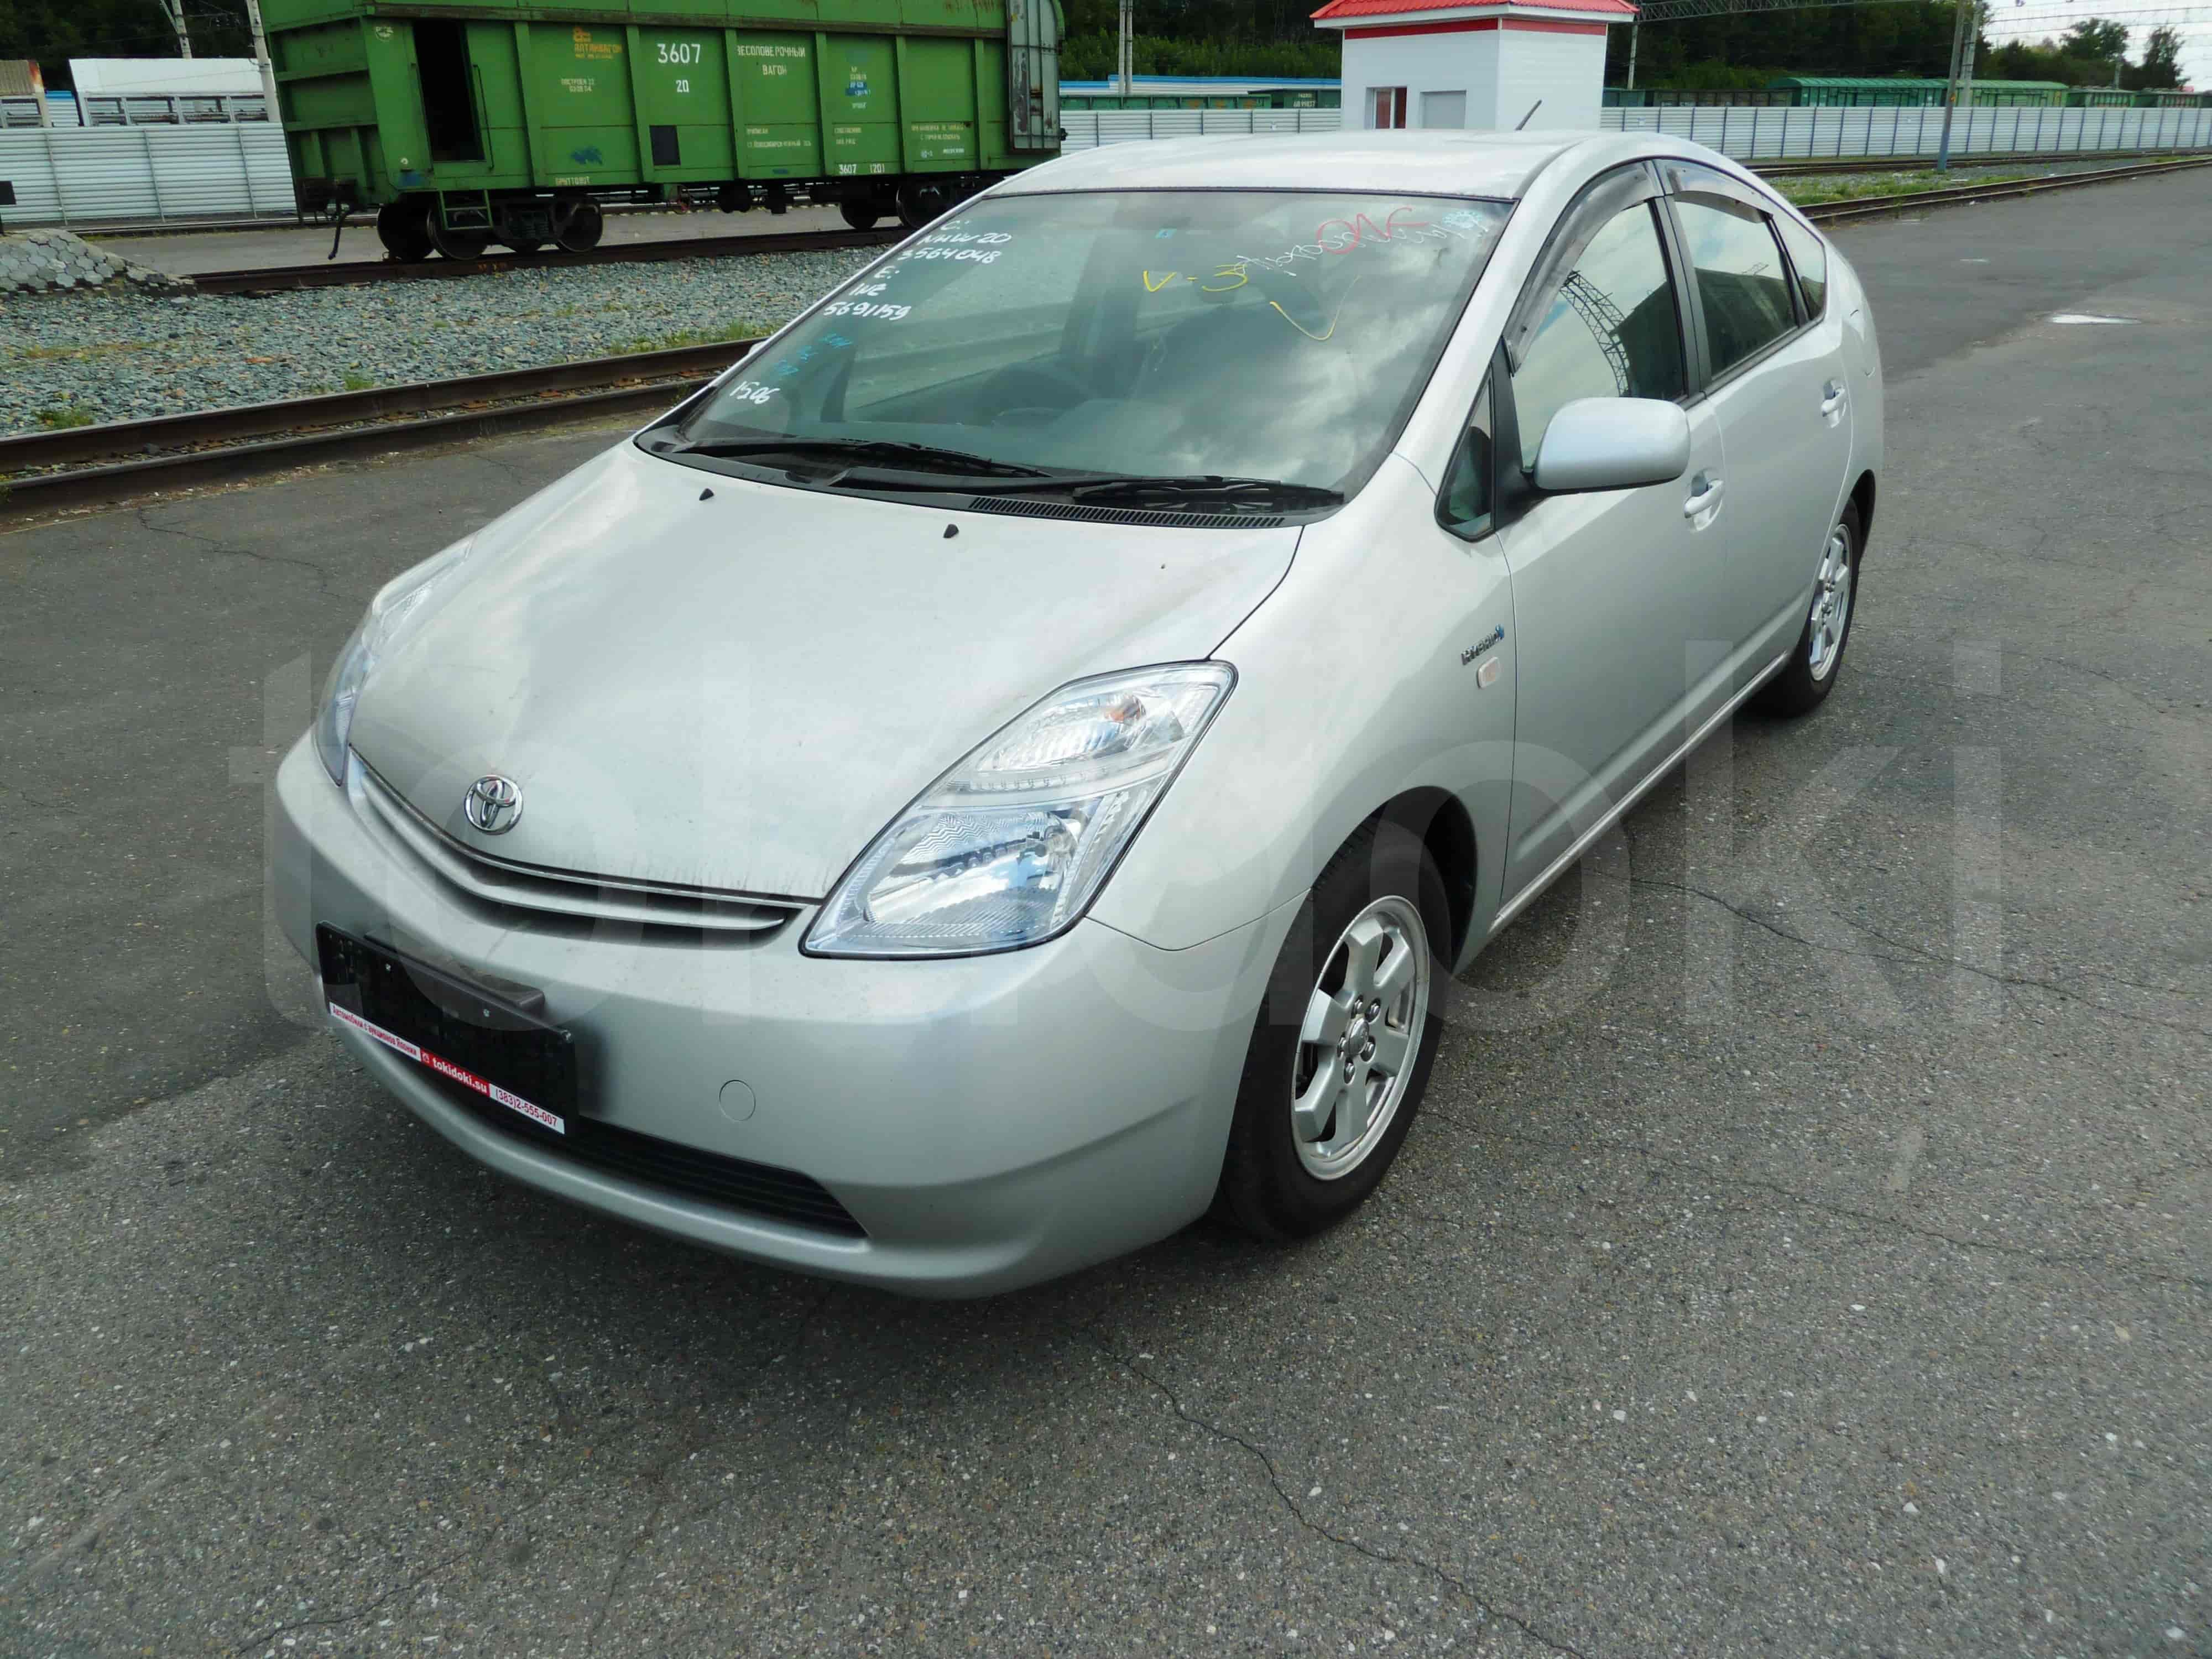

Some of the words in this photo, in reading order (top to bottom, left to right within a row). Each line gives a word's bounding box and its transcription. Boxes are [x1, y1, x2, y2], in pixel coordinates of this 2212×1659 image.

[657, 43, 701, 64] 3607
[762, 64, 787, 76] ВАГОН
[676, 79, 690, 93] 20
[838, 163, 857, 174] 3607
[897, 247, 1002, 264] 3564048
[823, 301, 912, 321] 5691159
[432, 1057, 487, 1094] tokidoki.su
[495, 1088, 559, 1127] (383)2-555-007
